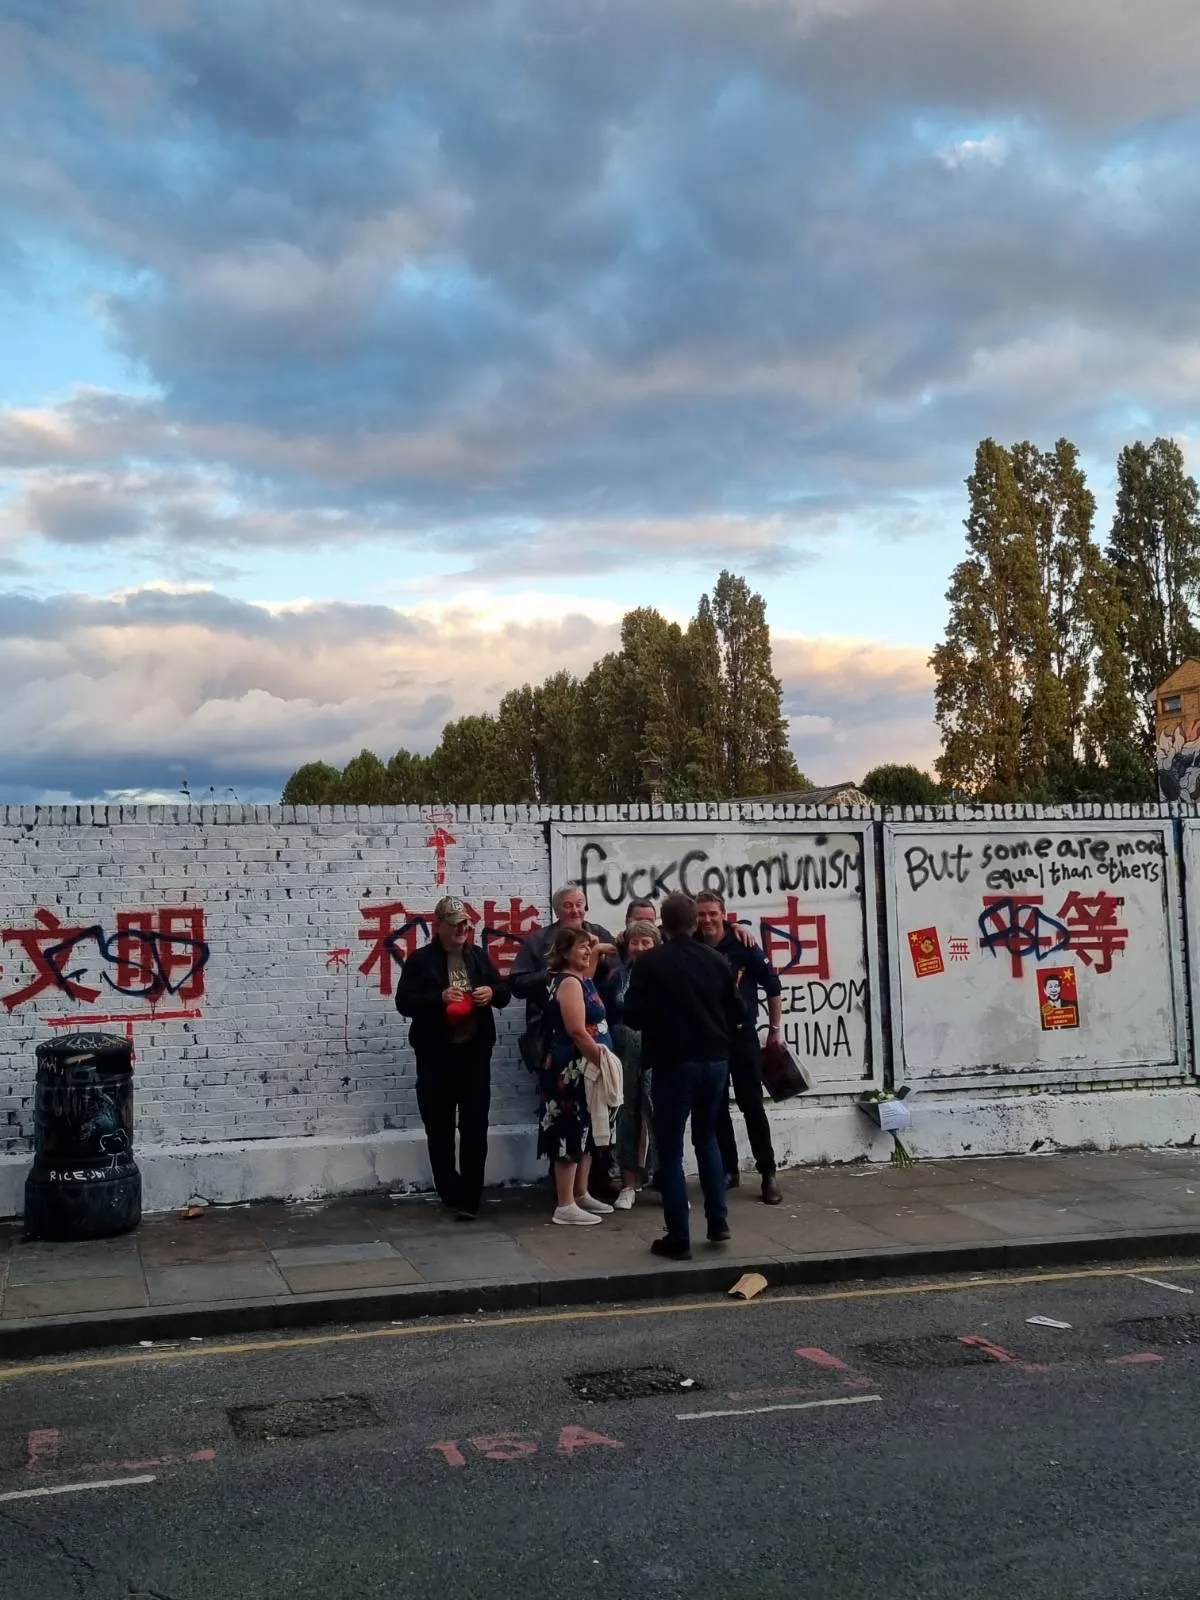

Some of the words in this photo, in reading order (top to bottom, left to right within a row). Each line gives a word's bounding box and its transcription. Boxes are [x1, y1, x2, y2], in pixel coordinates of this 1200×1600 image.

[904, 844, 973, 892] But
[980, 838, 1053, 868] some
[1057, 837, 1110, 861] are
[986, 863, 1044, 889] equal
[1049, 861, 1093, 886] than
[1097, 857, 1160, 883] others
[1, 904, 205, 1009] 文明
[980, 890, 1128, 978] 平等
[757, 979, 868, 1014] REEDOM
[757, 1015, 852, 1057] HINA
